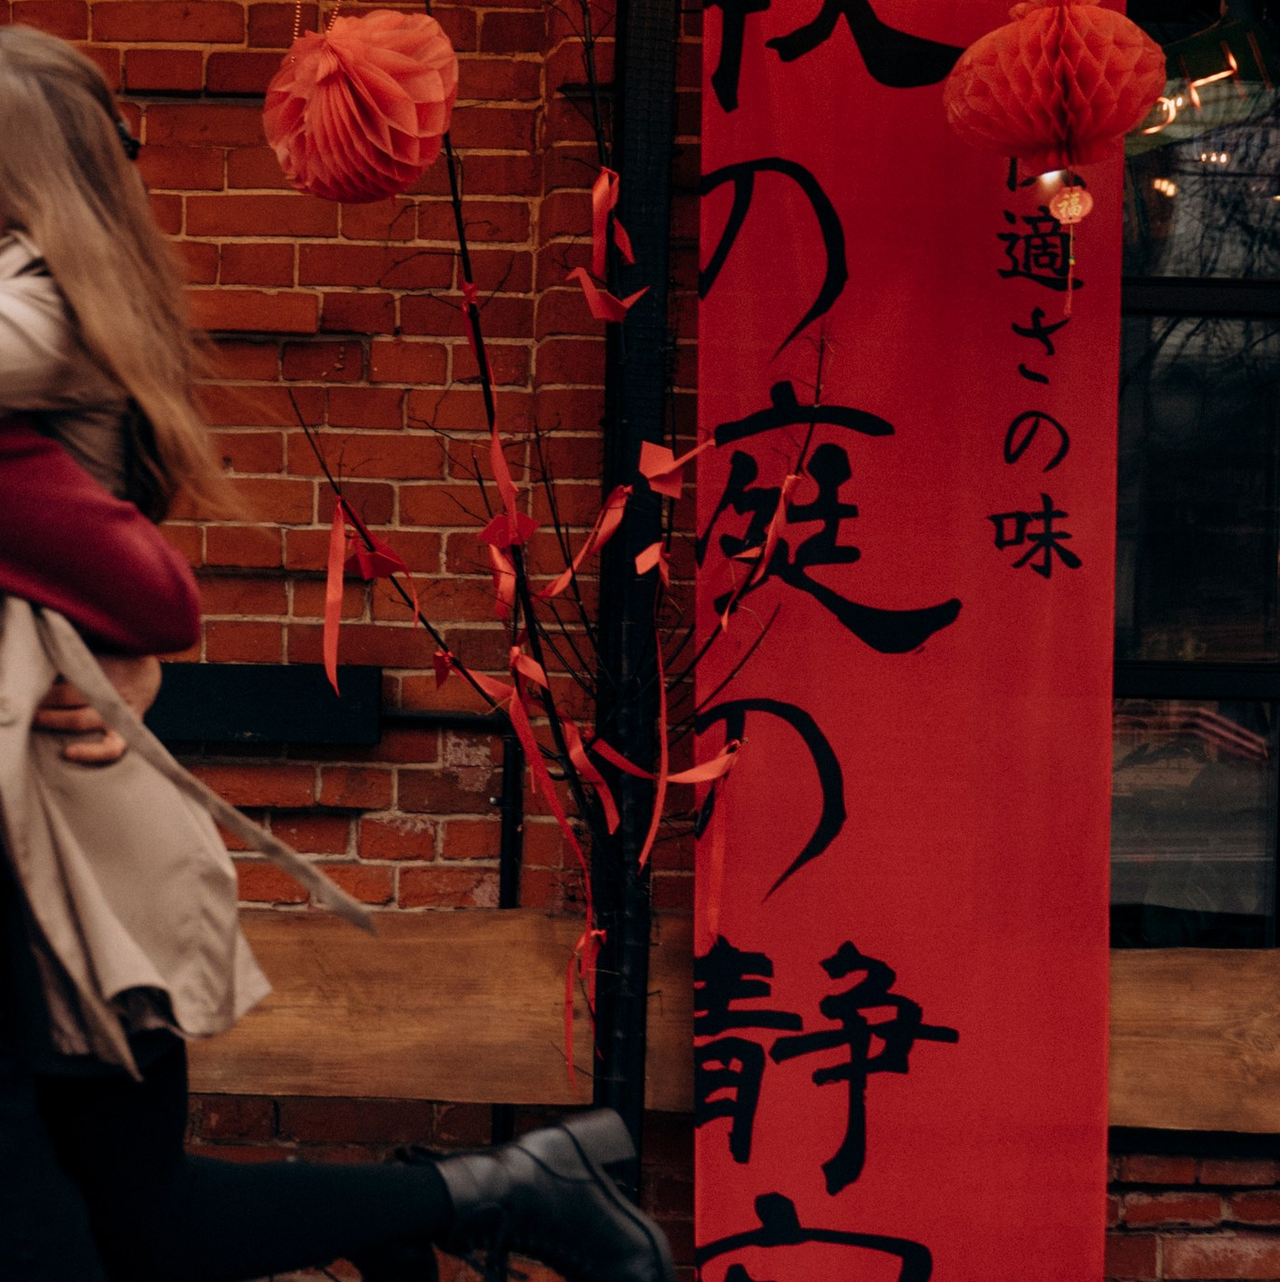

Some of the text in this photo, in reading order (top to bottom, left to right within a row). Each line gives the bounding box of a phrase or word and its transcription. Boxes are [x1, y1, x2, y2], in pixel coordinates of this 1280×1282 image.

[1056, 192, 1083, 218] 福
[988, 156, 1086, 580] 適さの味
